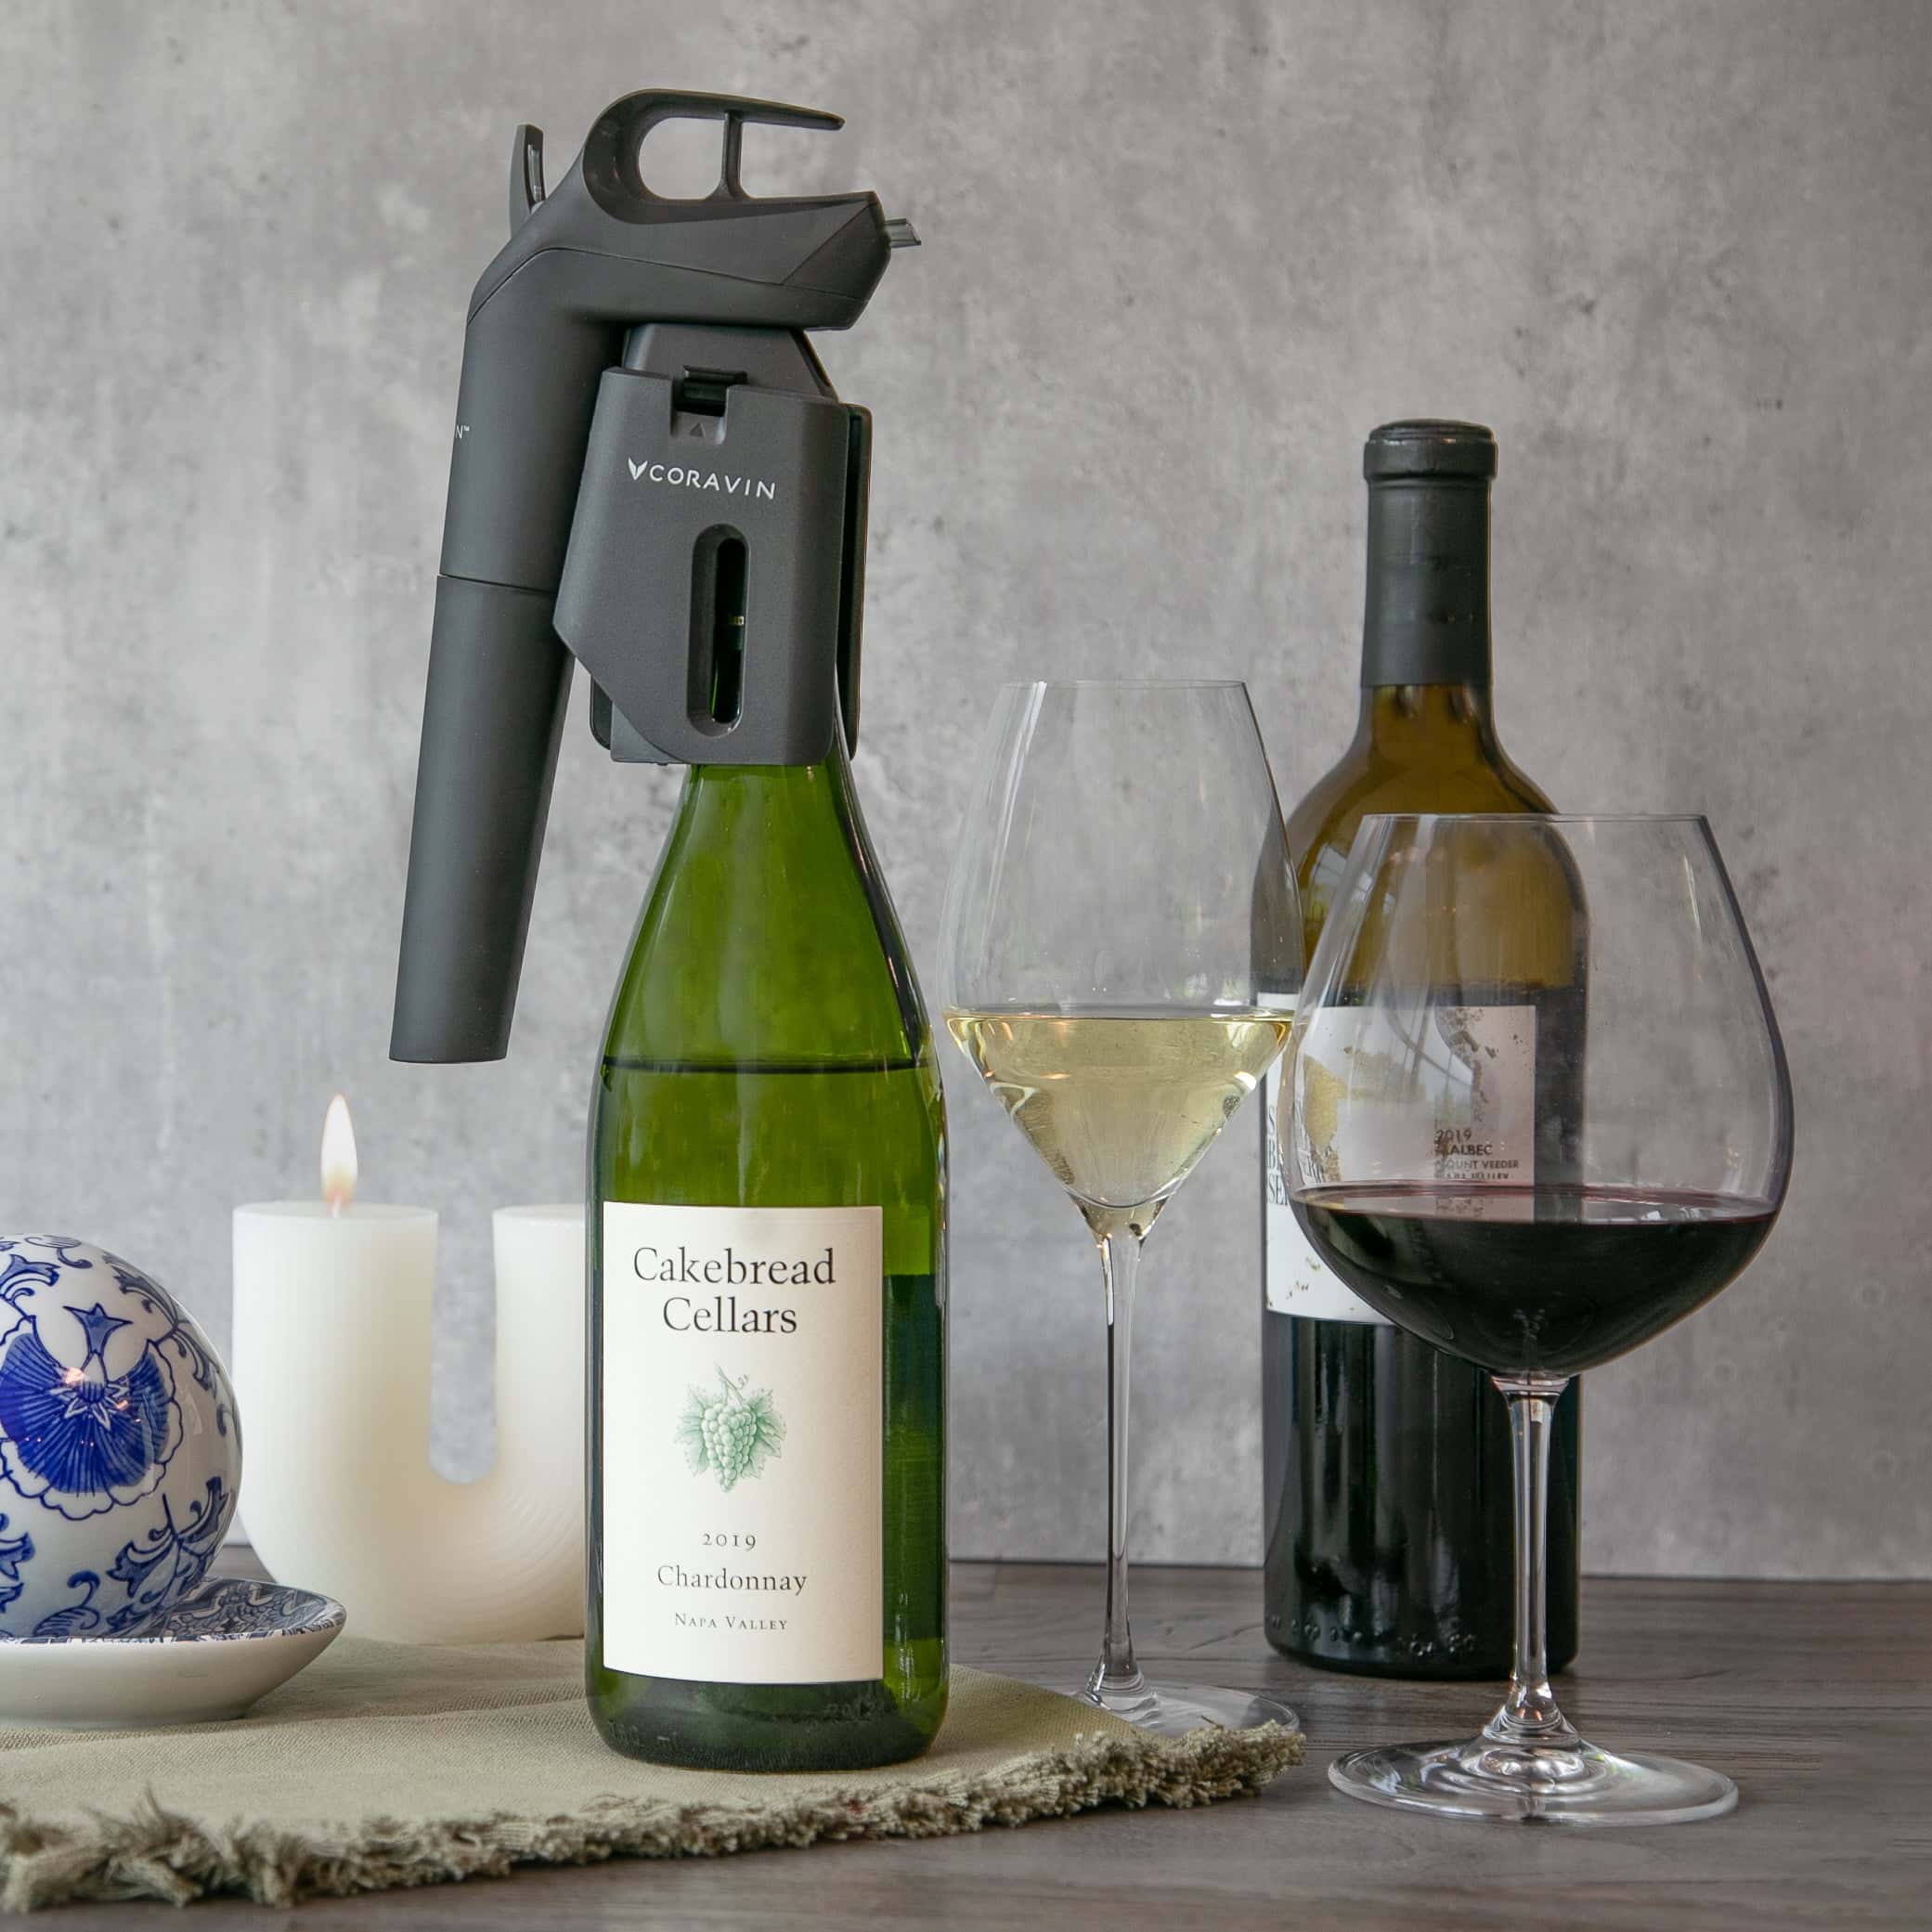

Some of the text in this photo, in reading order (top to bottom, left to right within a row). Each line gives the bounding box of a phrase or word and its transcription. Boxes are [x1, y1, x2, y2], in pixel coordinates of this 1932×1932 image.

[649, 464, 776, 500] CORAVIN
[1435, 1129, 1472, 1144] 2019
[633, 1245, 836, 1286] Cakebread
[662, 1295, 798, 1334] Cellars
[702, 1532, 758, 1551] 2019
[656, 1564, 808, 1596] Chardonnay
